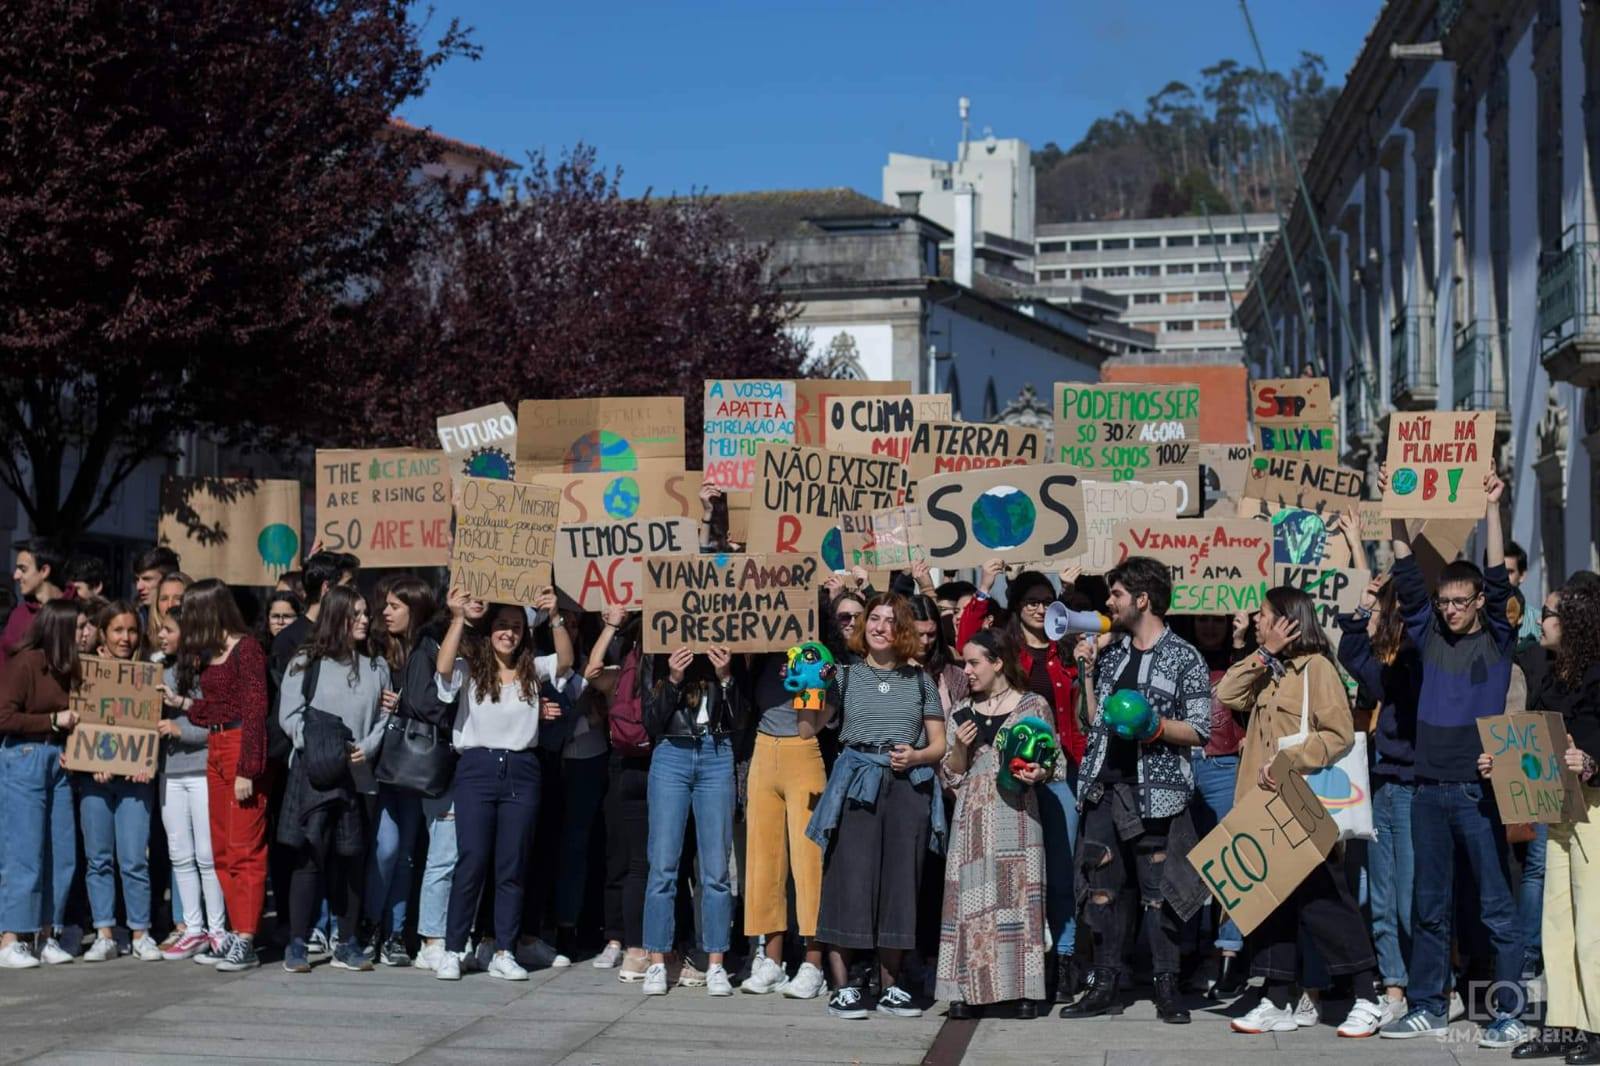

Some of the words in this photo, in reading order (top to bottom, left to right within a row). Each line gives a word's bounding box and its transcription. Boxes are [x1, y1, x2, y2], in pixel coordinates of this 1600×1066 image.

[710, 382, 723, 398] A
[733, 382, 783, 399] VOSSA
[716, 400, 786, 419] APATIA
[831, 402, 844, 430] O
[438, 415, 516, 451] FUTURO
[911, 423, 929, 453] A
[934, 424, 1009, 457] TERRA
[1016, 433, 1037, 459] A
[1139, 421, 1185, 442] AGORA
[1454, 413, 1480, 440] HÁ
[1061, 446, 1095, 468] MAS
[1101, 446, 1151, 468] SOMOS
[1403, 442, 1478, 463] PLANETA
[323, 462, 361, 485] THE
[763, 447, 822, 482] NÃO
[827, 455, 900, 491] EXISTE
[1269, 458, 1297, 481] WE
[1300, 463, 1362, 498] NEED
[326, 491, 359, 508] ARE
[432, 481, 446, 503] &
[765, 479, 803, 514] UM
[806, 483, 893, 519] PLANETA
[324, 518, 362, 550] SO
[369, 519, 414, 550] ARE
[420, 519, 448, 549] WE
[560, 522, 643, 558] TEMOS
[648, 521, 682, 551] DE
[1129, 527, 1199, 550] VIANA
[647, 559, 719, 590] VIANA
[1202, 566, 1243, 580] AMA
[73, 730, 156, 767] NOW!
[1490, 723, 1542, 756] SAVE
[1201, 833, 1268, 911] ECO
